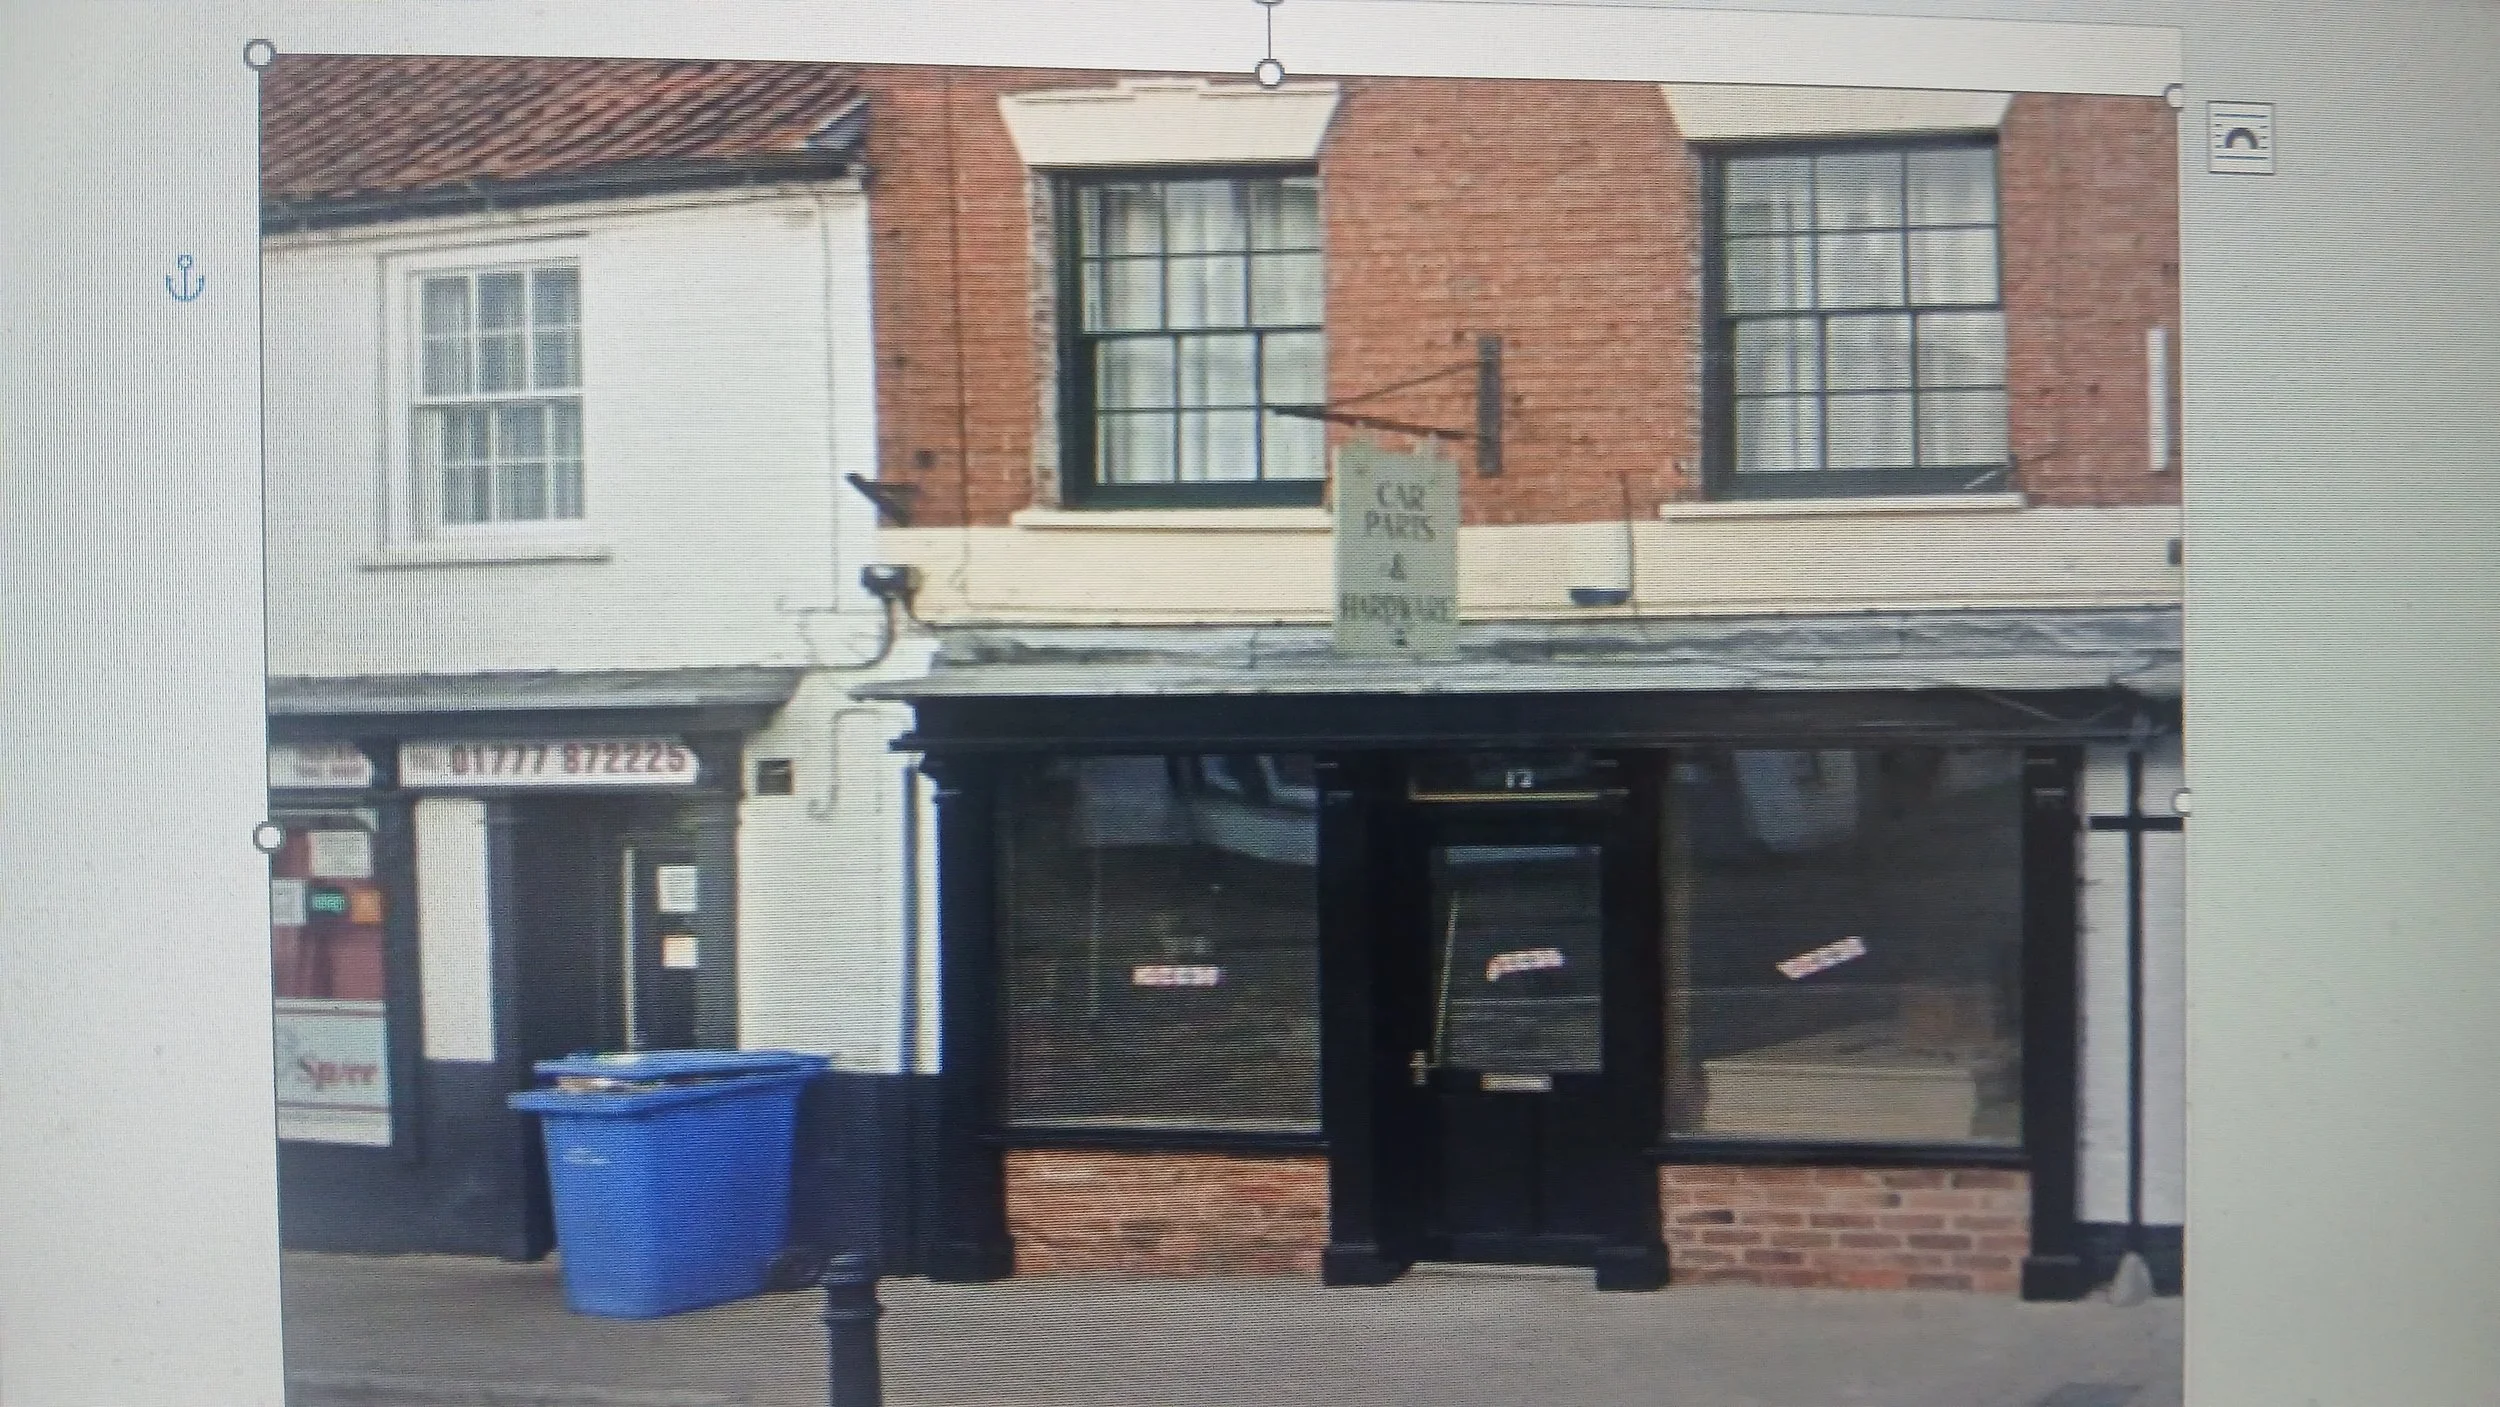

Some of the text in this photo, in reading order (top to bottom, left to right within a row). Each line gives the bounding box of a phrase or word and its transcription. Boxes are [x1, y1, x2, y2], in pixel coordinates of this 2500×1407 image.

[1376, 480, 1426, 512] CAR
[1364, 510, 1437, 542] PARTS
[1388, 552, 1407, 581] &
[450, 743, 549, 775] 01777
[562, 742, 686, 775] 872225
